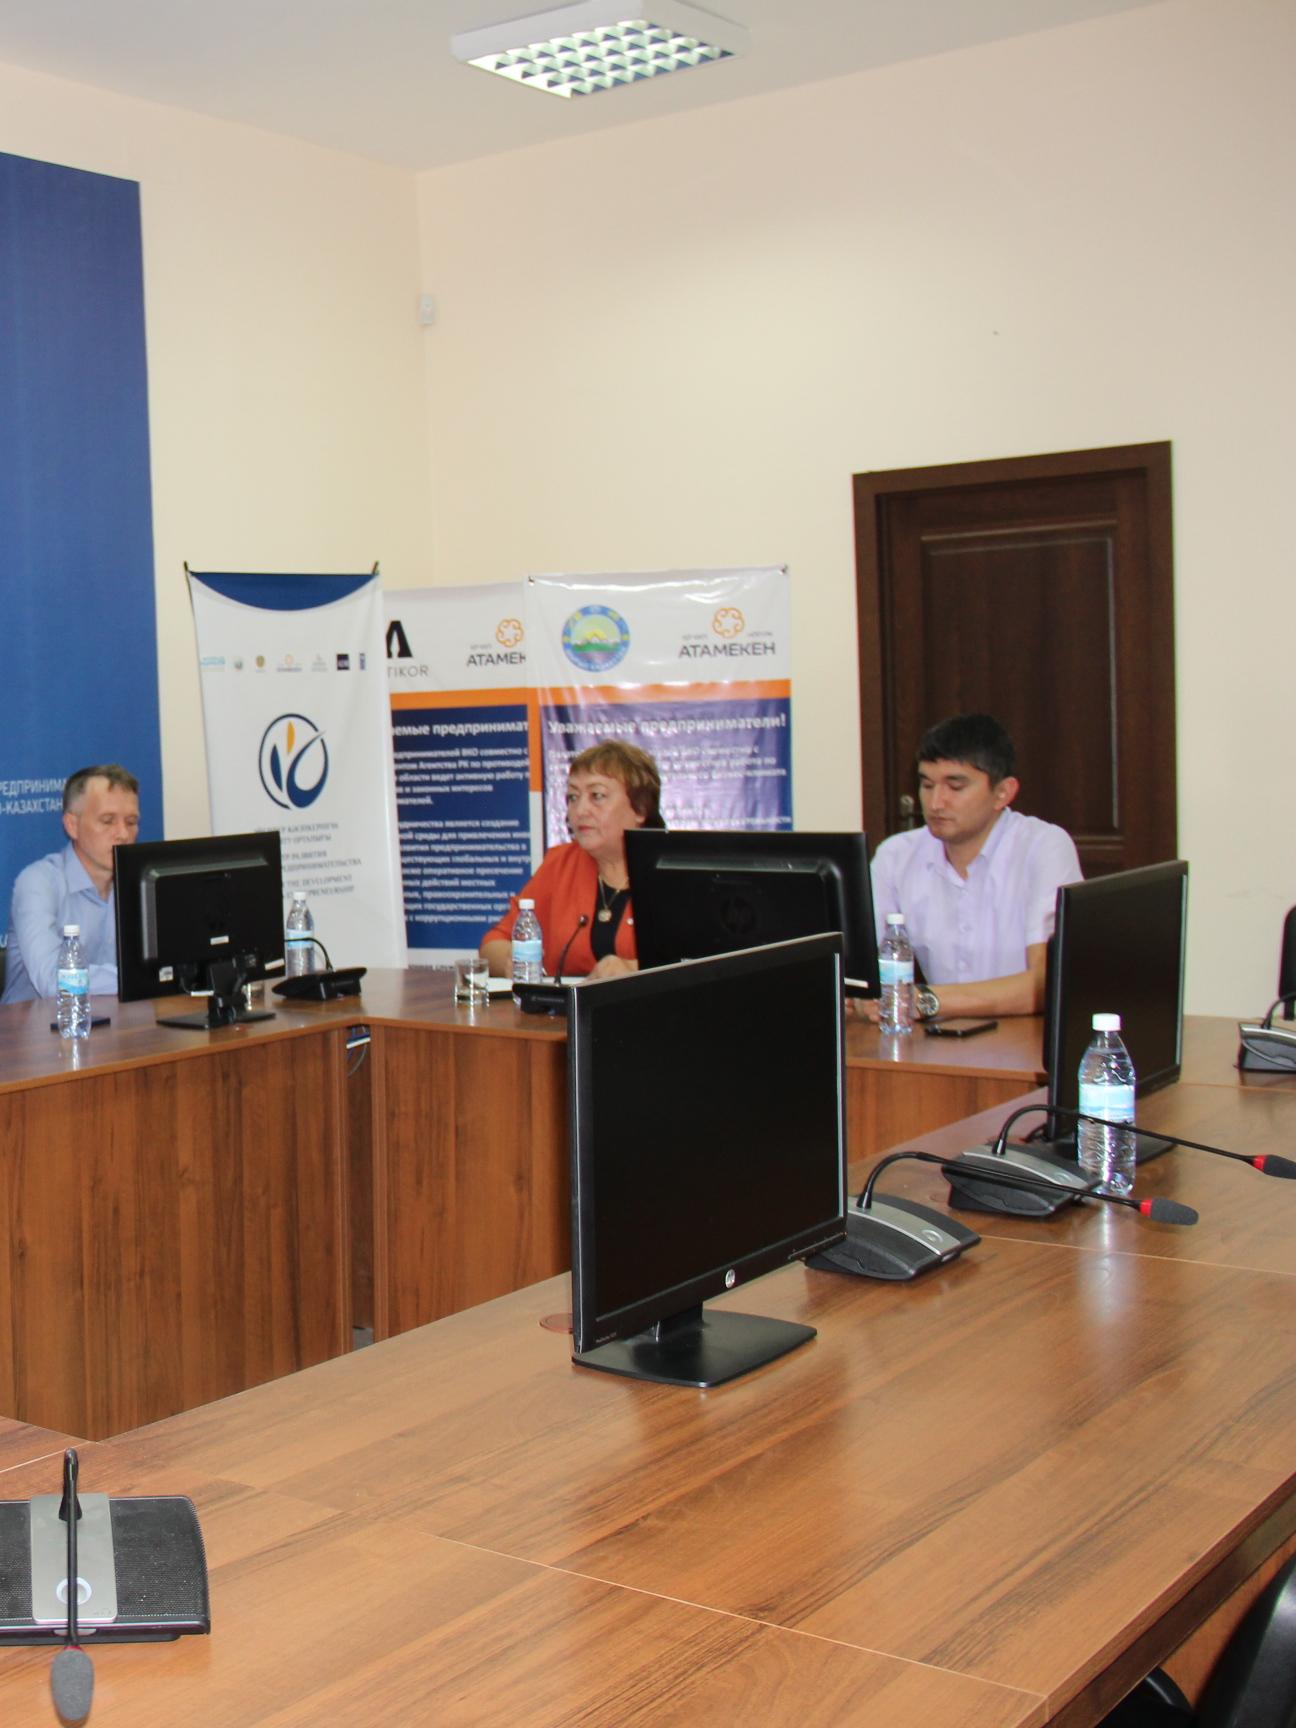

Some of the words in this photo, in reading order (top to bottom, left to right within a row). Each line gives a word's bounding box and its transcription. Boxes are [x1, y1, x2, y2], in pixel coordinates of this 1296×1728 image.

[678, 642, 776, 659] АТАМЕКЕН
[548, 719, 636, 737] Уважаемые
[641, 713, 786, 738] предприниматели!
